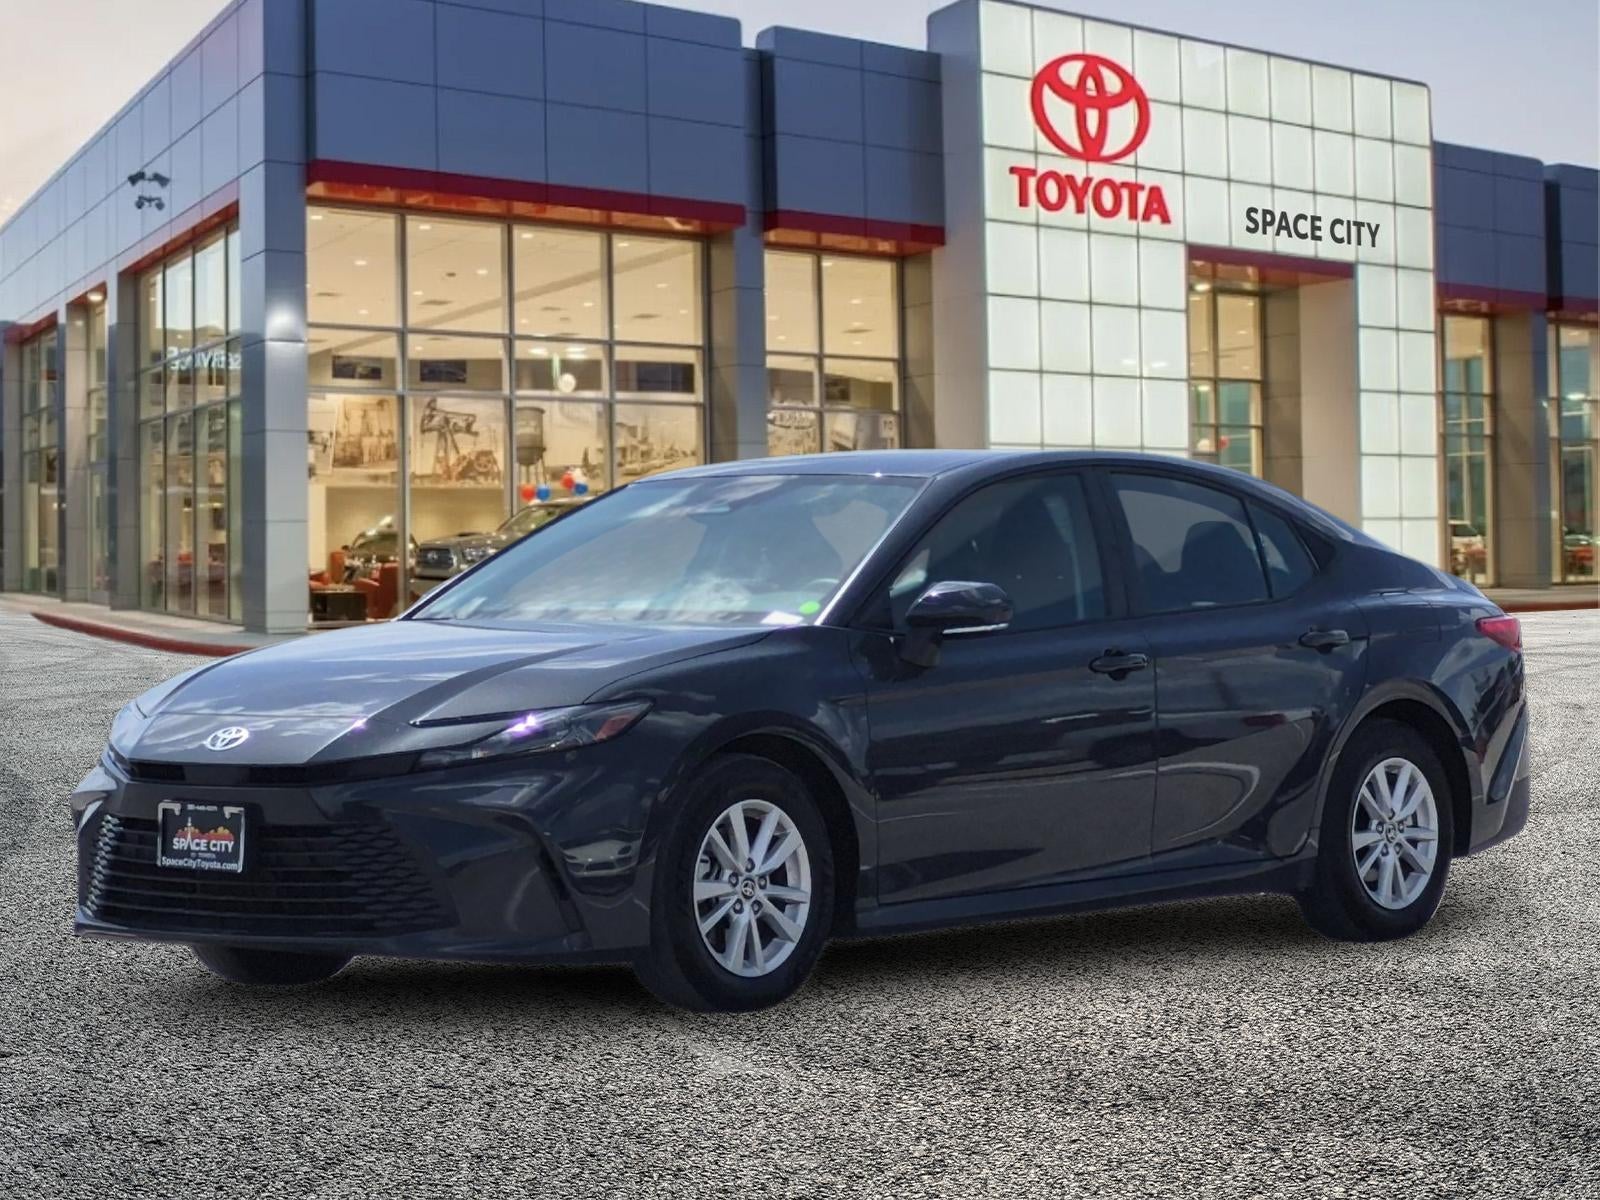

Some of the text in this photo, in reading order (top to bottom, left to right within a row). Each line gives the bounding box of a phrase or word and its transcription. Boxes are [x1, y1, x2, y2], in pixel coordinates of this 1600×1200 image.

[1009, 166, 1171, 224] TOYOTA
[1245, 206, 1381, 248] SPACE CITY
[172, 837, 234, 853] SPACE CITY
[161, 856, 238, 870] SpaceCityToyota.com
